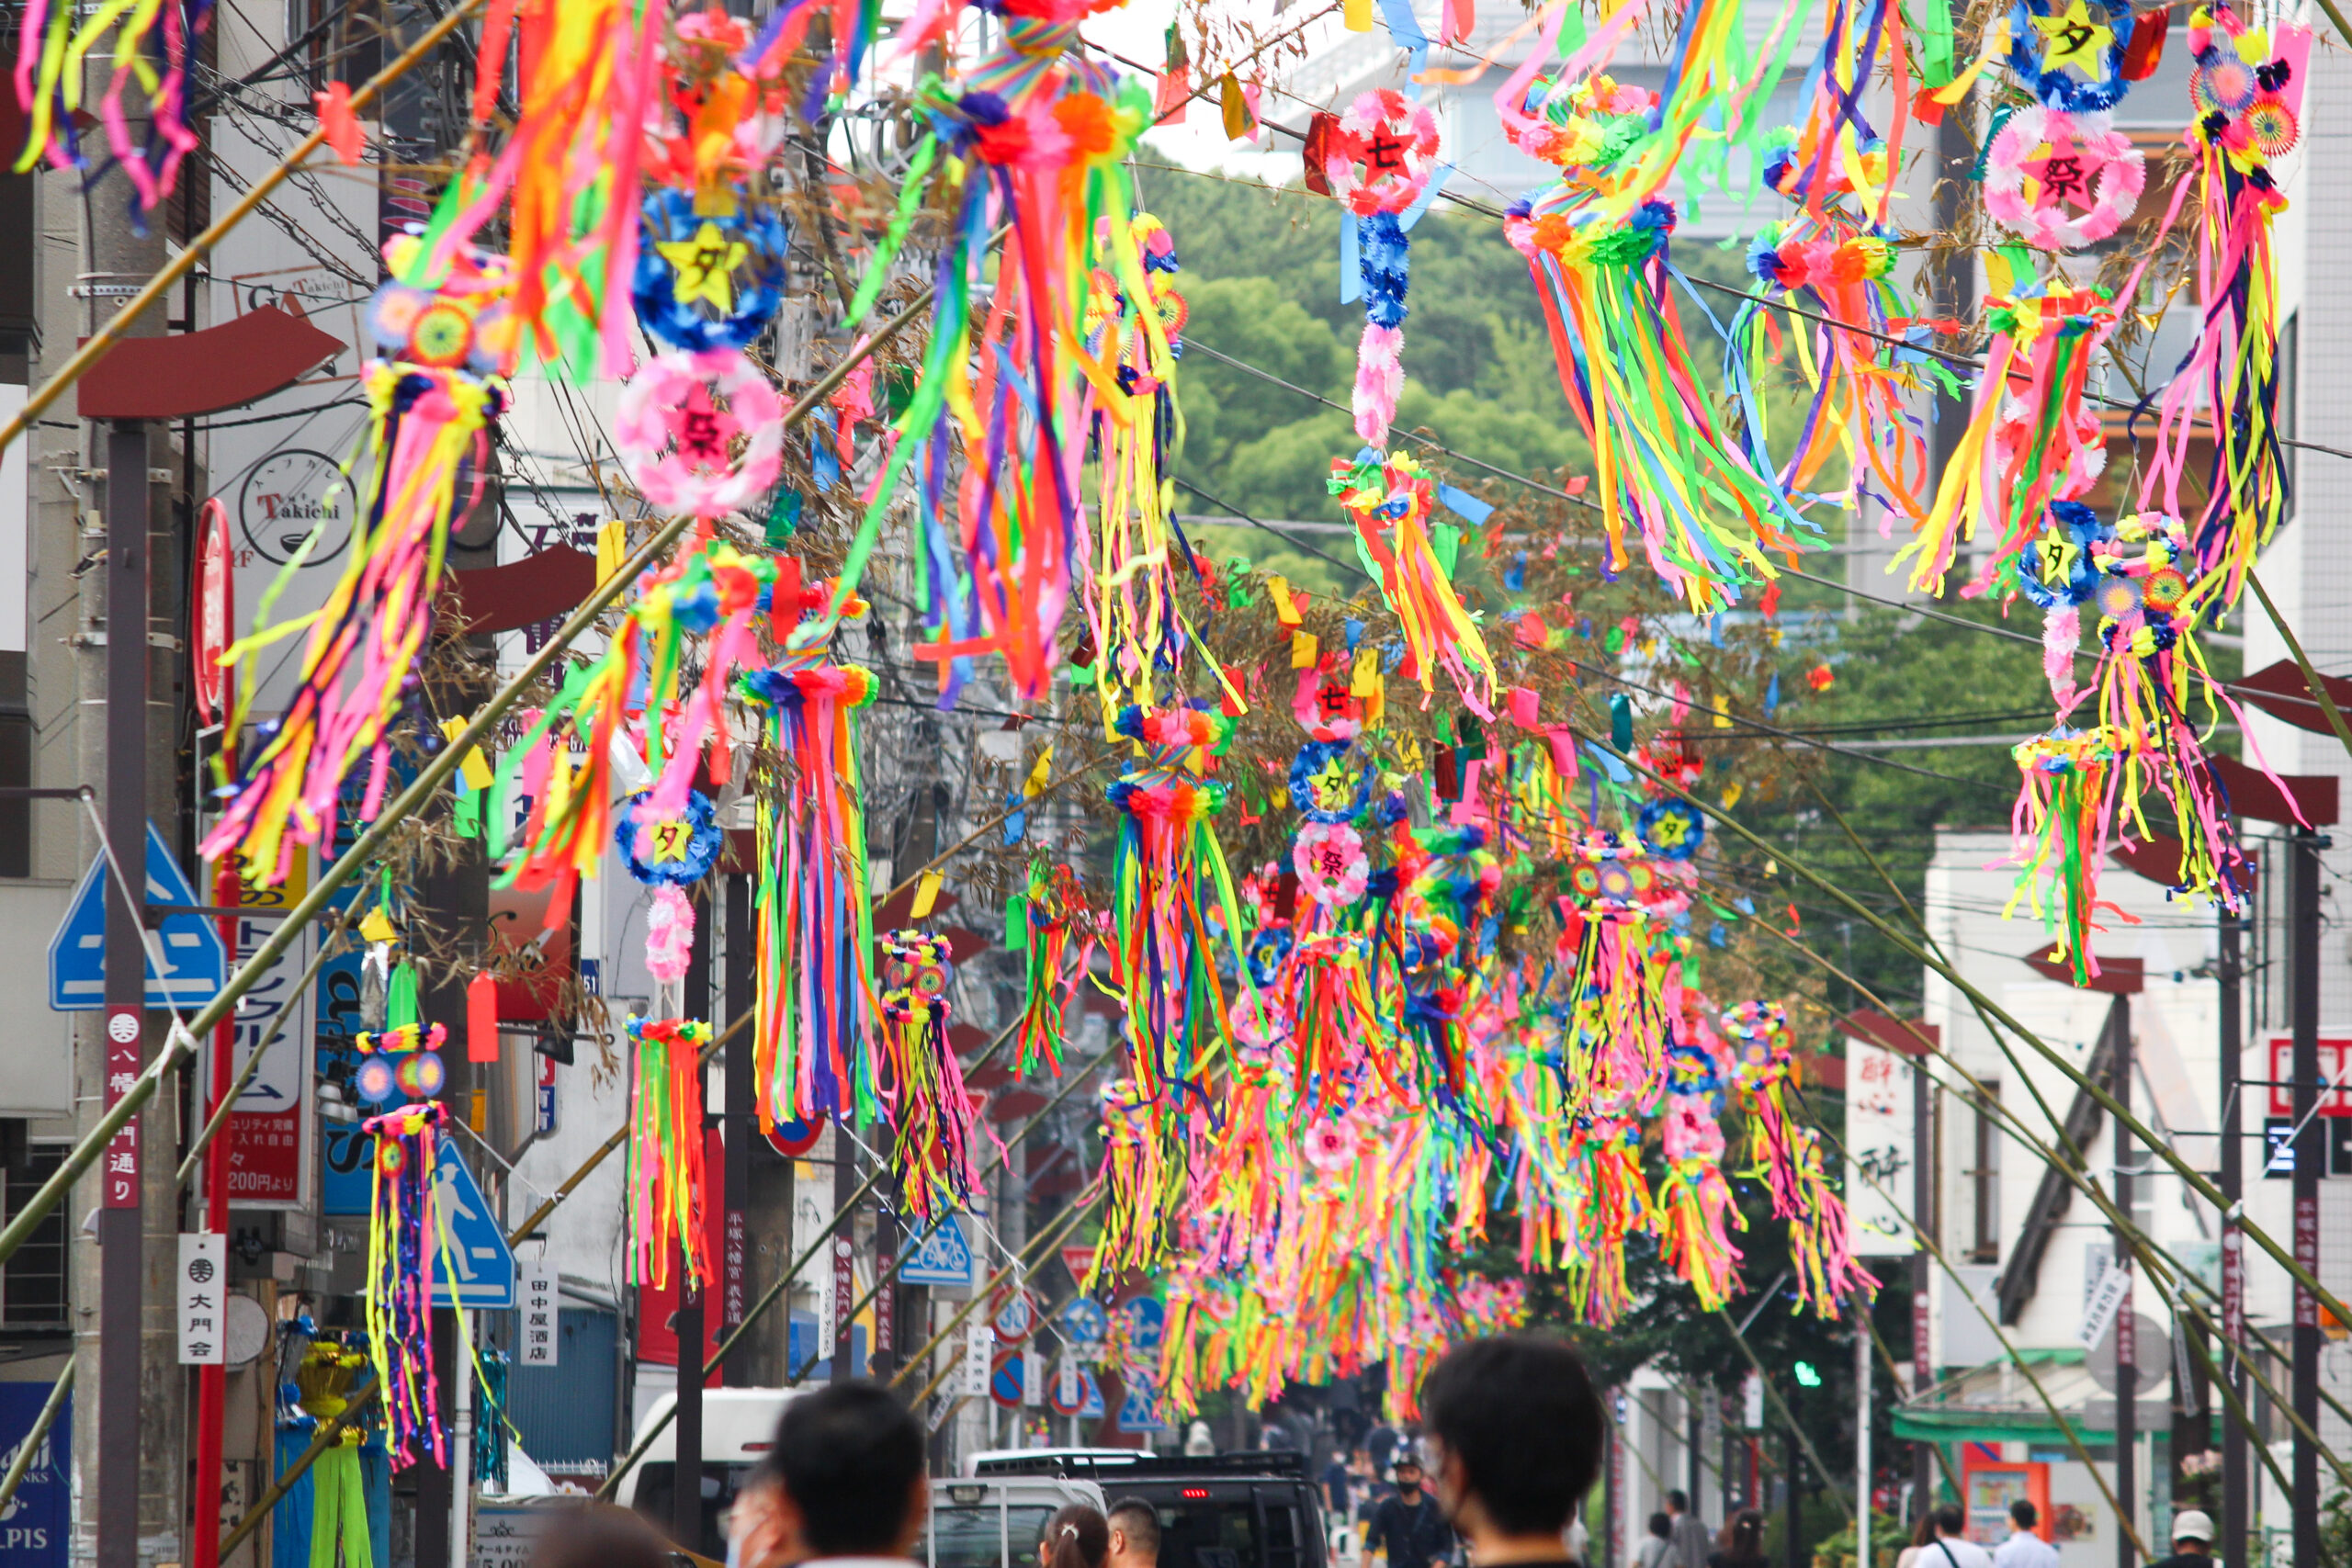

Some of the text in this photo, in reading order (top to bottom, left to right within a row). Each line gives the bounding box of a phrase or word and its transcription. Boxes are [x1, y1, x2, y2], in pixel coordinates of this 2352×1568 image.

[1366, 137, 1401, 168] 七
[2044, 156, 2084, 197] 祭
[684, 413, 719, 458] 祭
[256, 492, 340, 520] Takichi
[1321, 687, 1346, 711] 七
[1323, 849, 1343, 876] 祭
[109, 1049, 137, 1201] 八幡門通り
[188, 1293, 212, 1357] 大門会
[529, 1280, 548, 1359] 田中屋酒店
[999, 1301, 1028, 1329] 30
